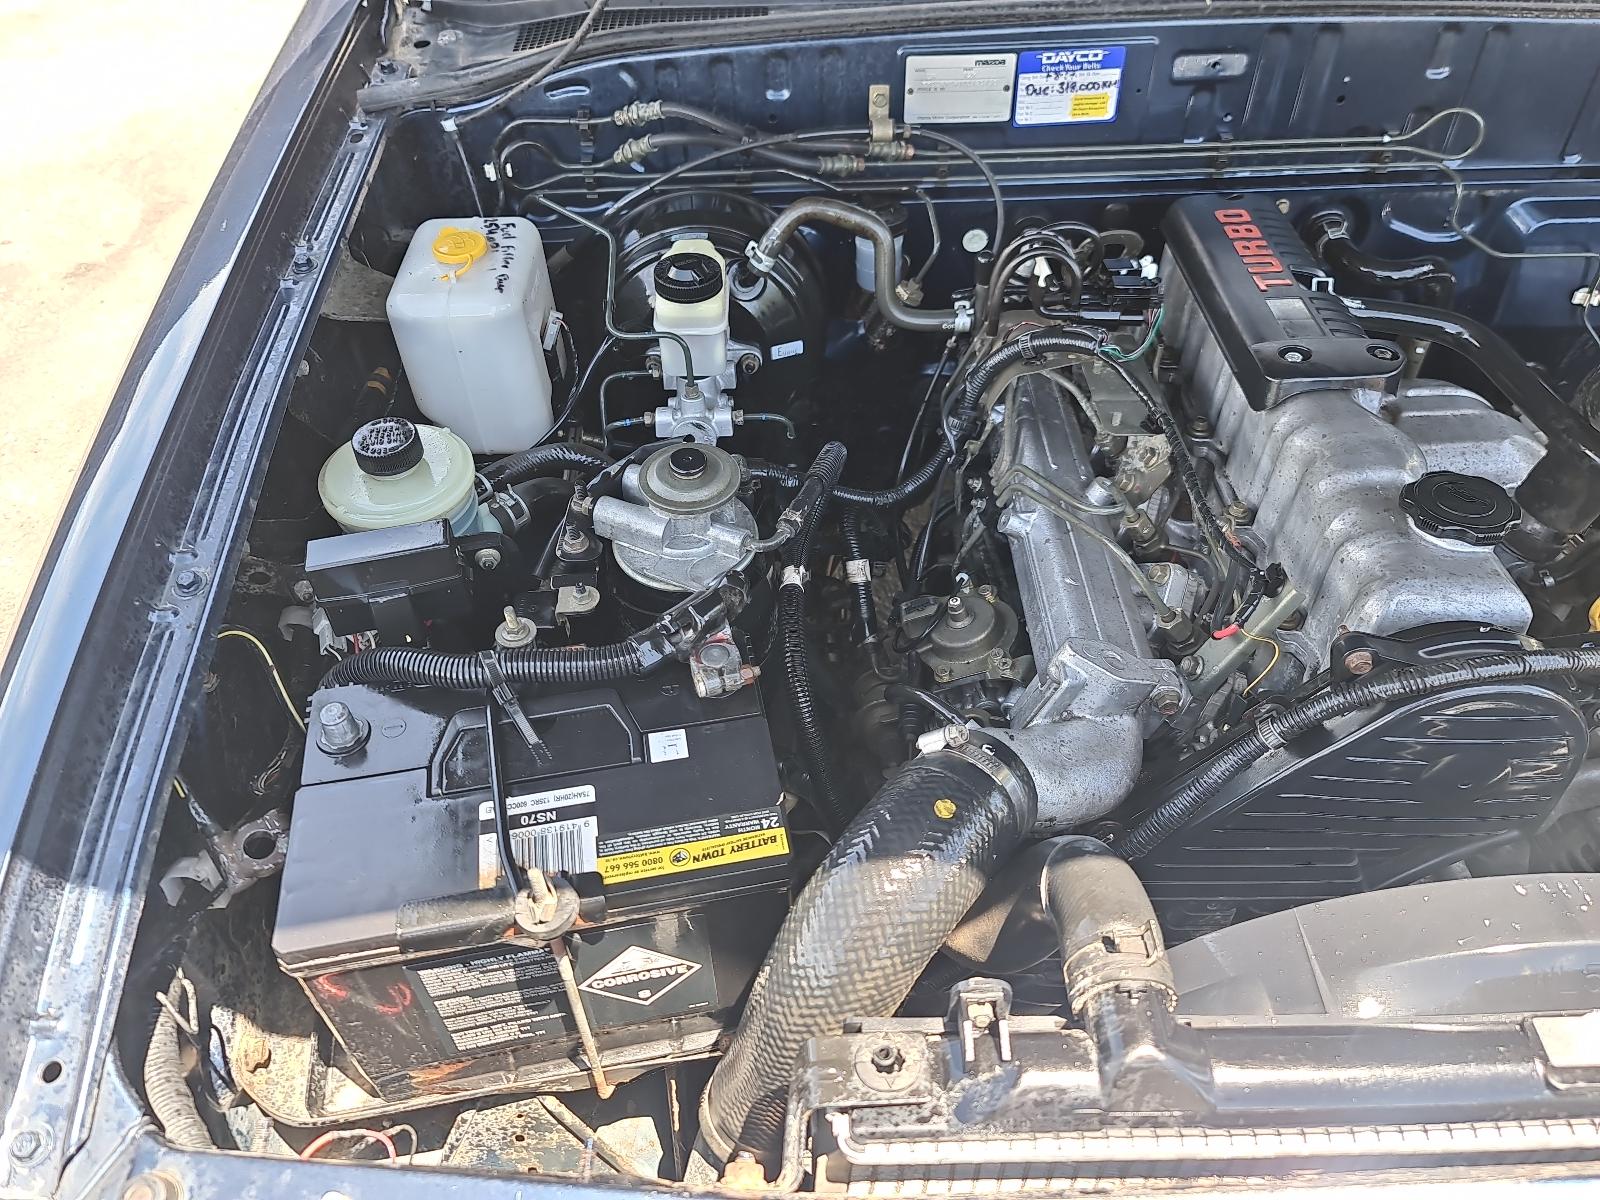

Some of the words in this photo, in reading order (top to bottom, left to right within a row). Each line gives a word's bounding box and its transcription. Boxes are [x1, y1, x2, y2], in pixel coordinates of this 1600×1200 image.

[1041, 50, 1104, 64] DAYCO
[1041, 64, 1064, 72] Check
[1065, 63, 1081, 71] Your
[1214, 208, 1293, 292] TURBO
[520, 811, 557, 826] NS70
[583, 820, 590, 828] 9
[724, 820, 760, 830] WARRANTY
[761, 816, 780, 829] 24
[730, 835, 777, 854] BATTERY
[642, 857, 663, 866] 0800
[693, 848, 726, 863] TOWN
[604, 865, 620, 873] 667
[623, 861, 639, 869] 566
[591, 965, 688, 989] CORROSIVE
